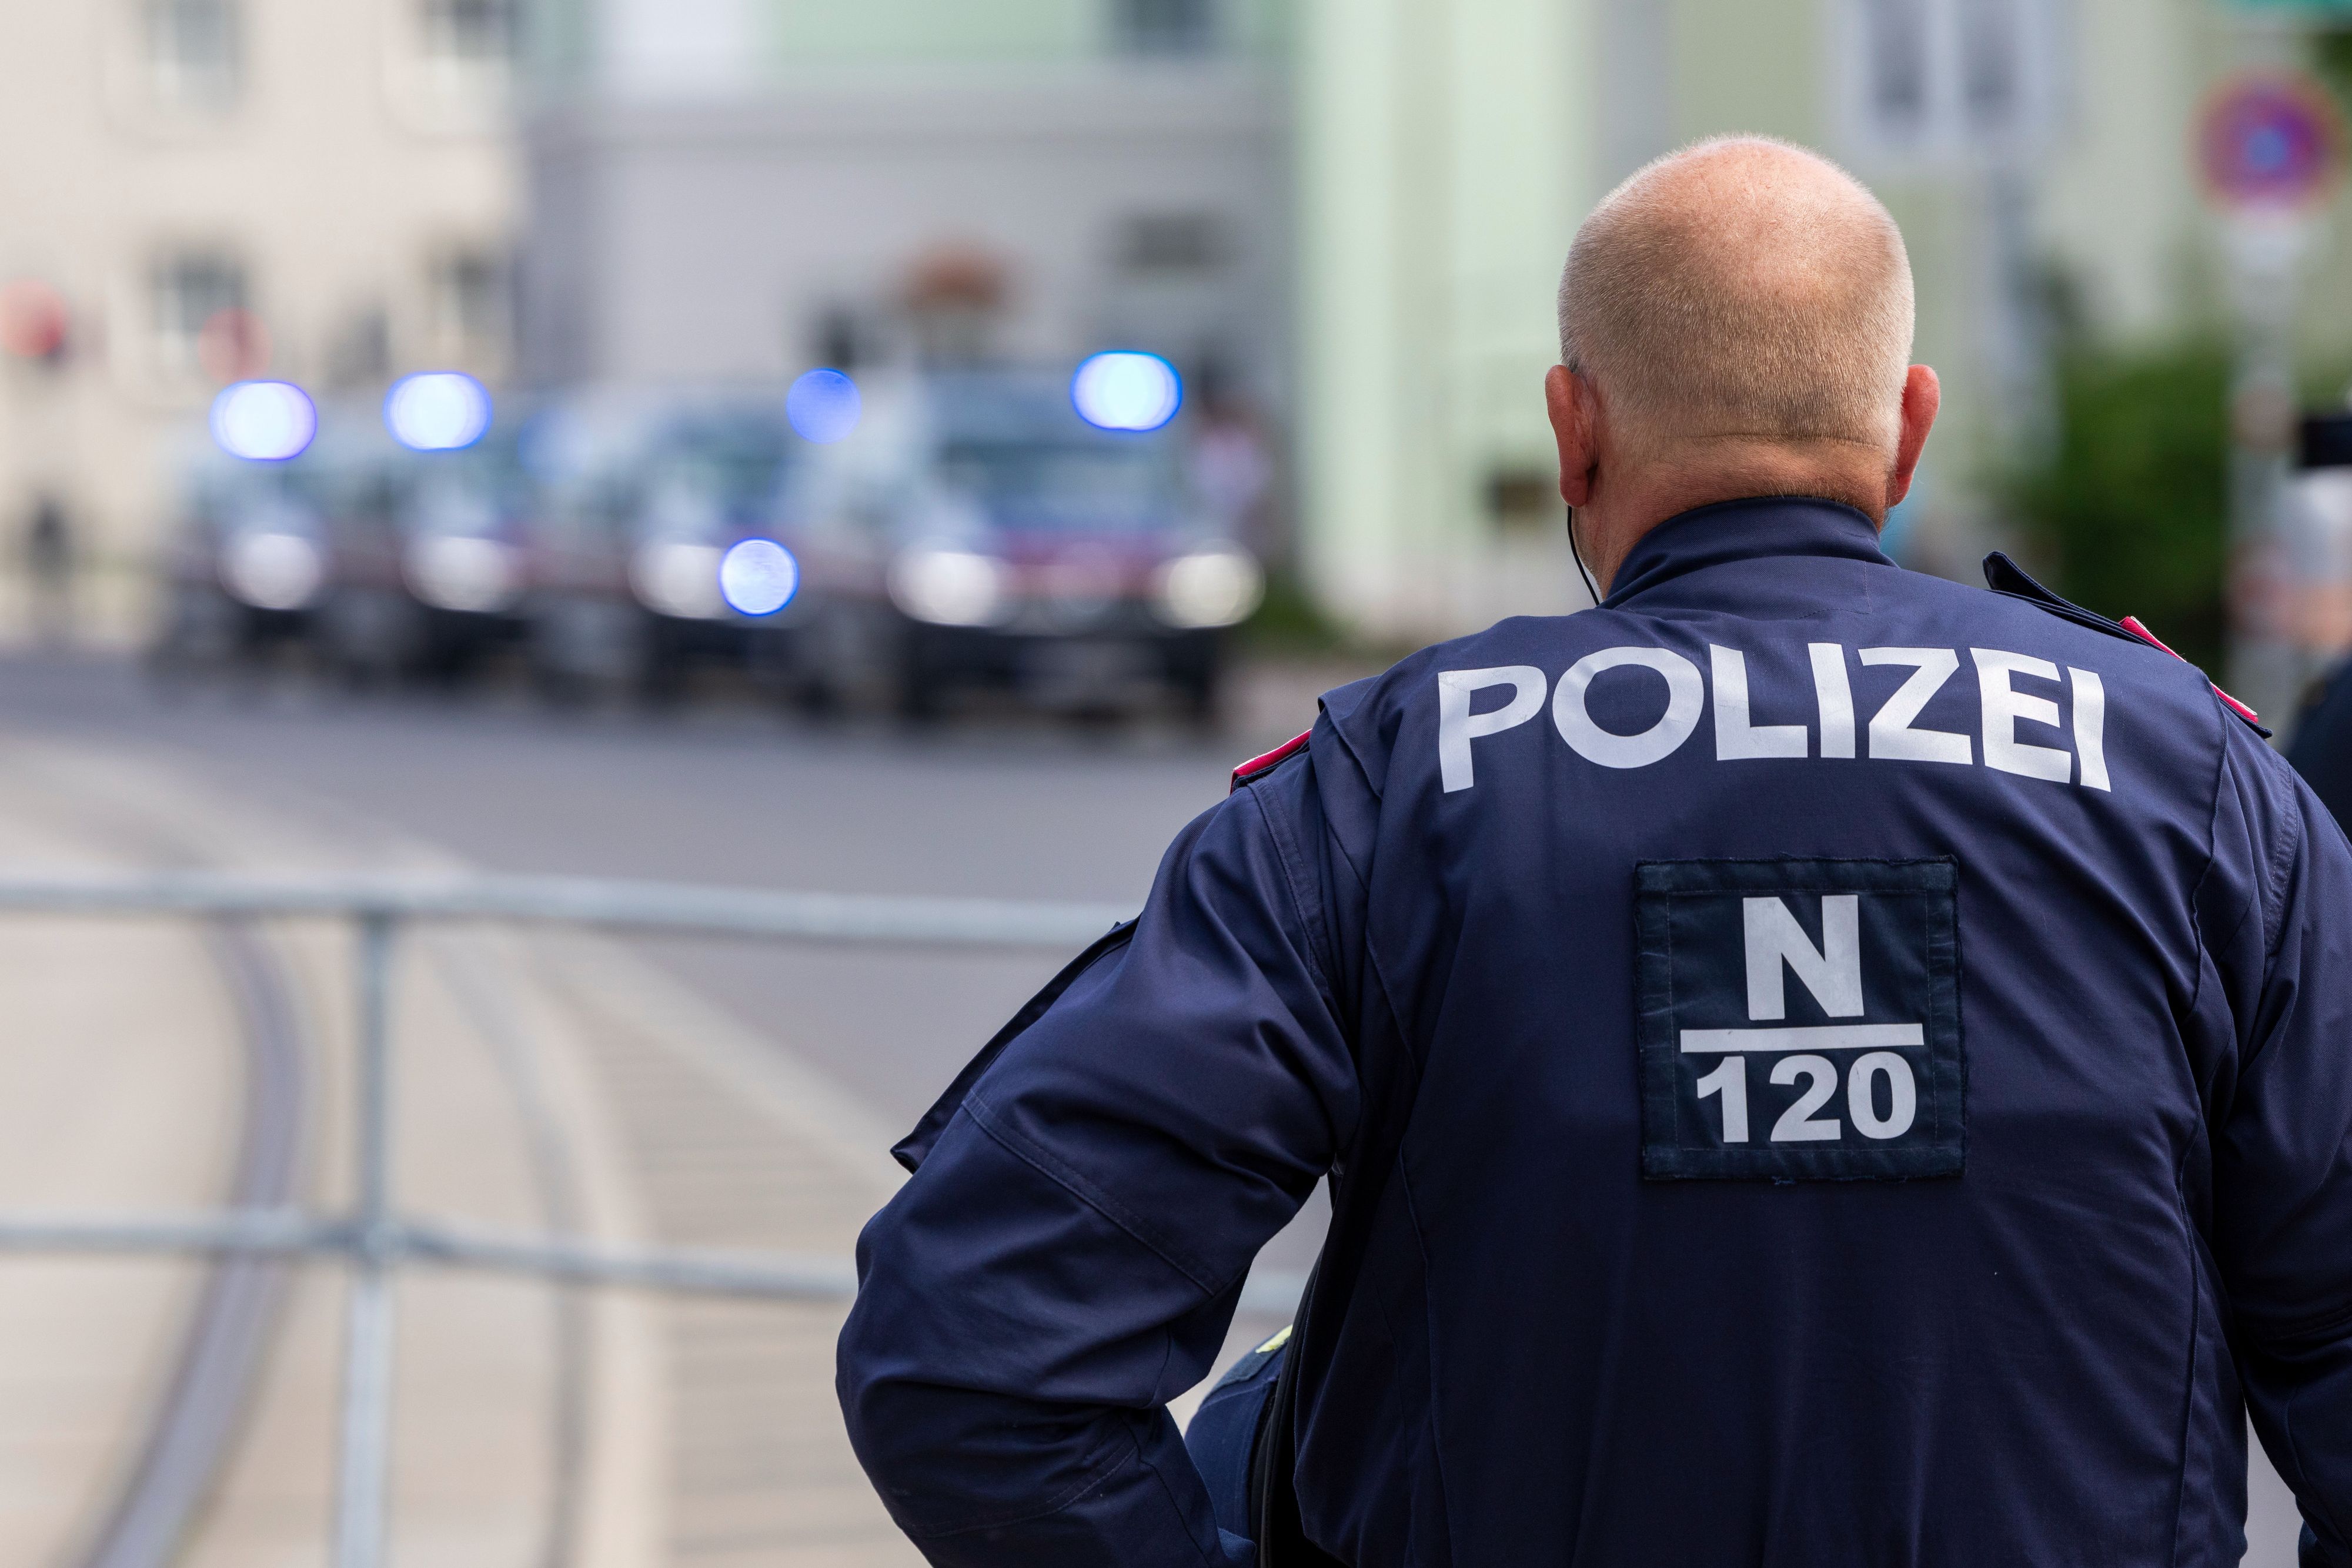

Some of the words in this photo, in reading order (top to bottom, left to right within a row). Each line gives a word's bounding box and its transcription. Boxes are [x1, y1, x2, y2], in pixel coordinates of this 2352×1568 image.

[1438, 643, 2111, 793] POLIZEI
[1743, 895, 1865, 1021] N
[1697, 1052, 1917, 1143] 120
